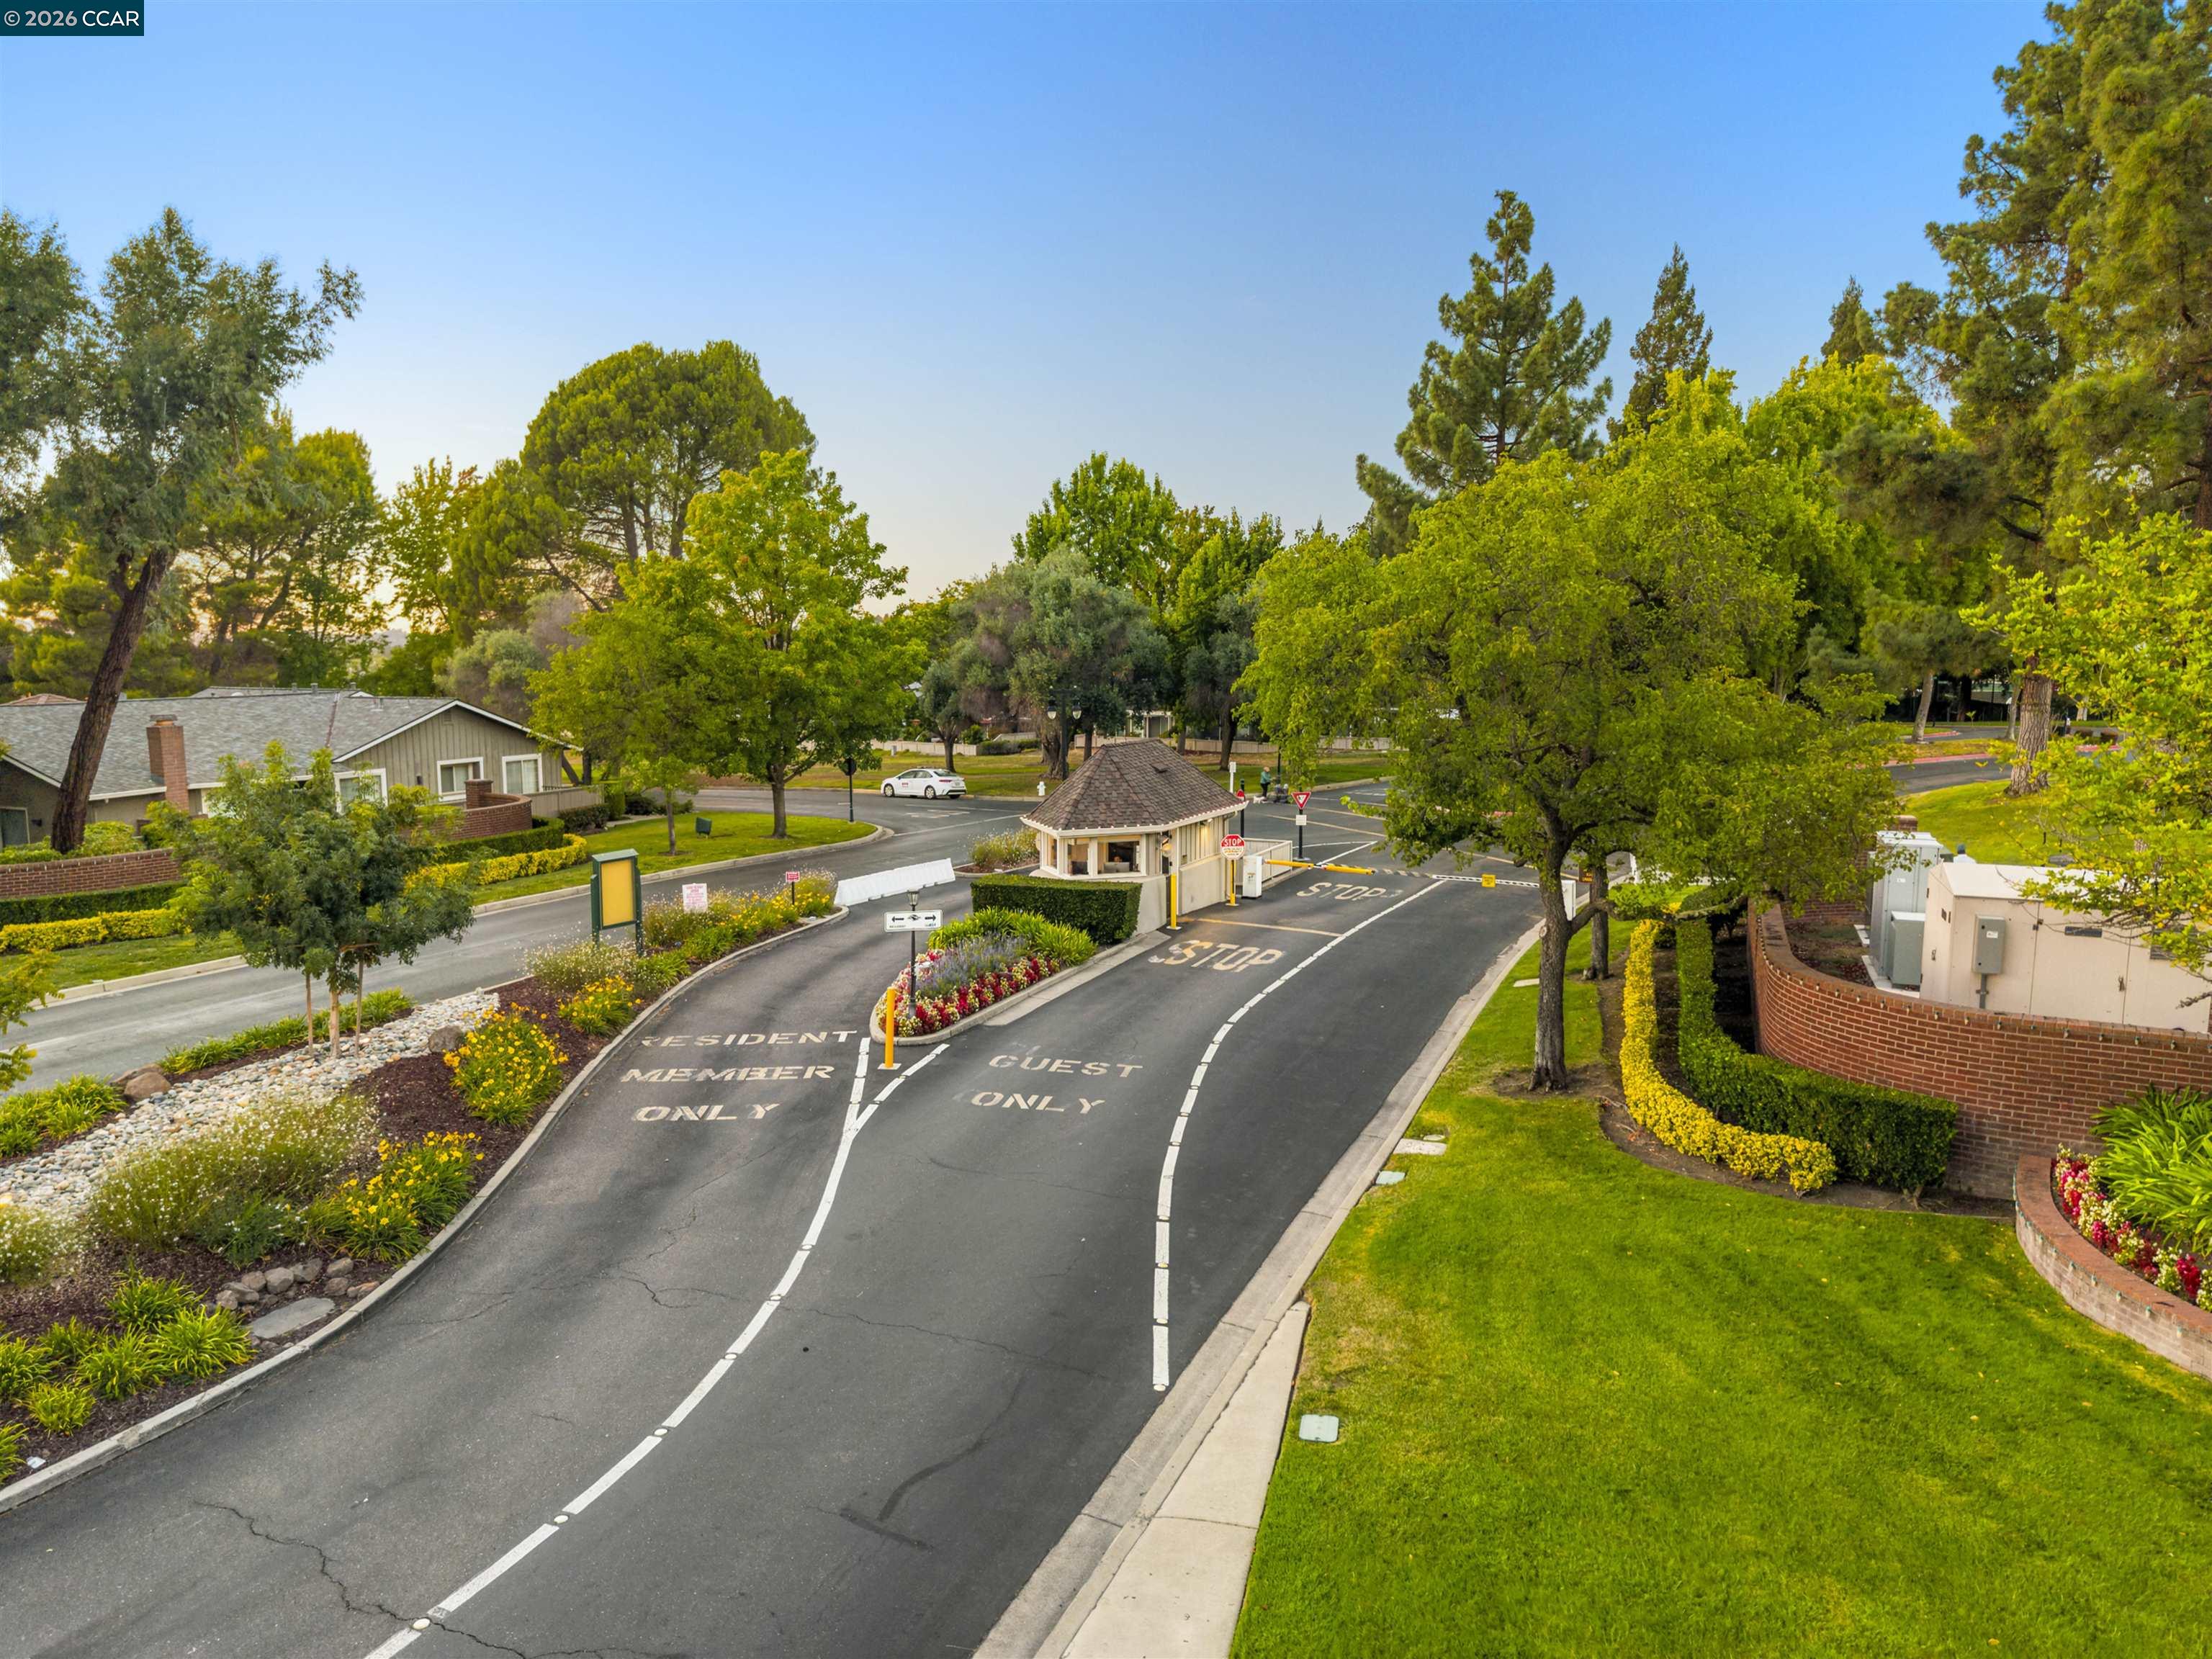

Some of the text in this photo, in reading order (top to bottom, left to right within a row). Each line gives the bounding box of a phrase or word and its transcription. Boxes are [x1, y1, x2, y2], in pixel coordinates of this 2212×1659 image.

[1297, 882, 1387, 901] STOP
[1148, 940, 1285, 972] STOP
[621, 1066, 835, 1082] MEMBER
[989, 1055, 1143, 1078] GUEST
[634, 1103, 780, 1121] ONLY
[971, 1092, 1105, 1114] ONLY
